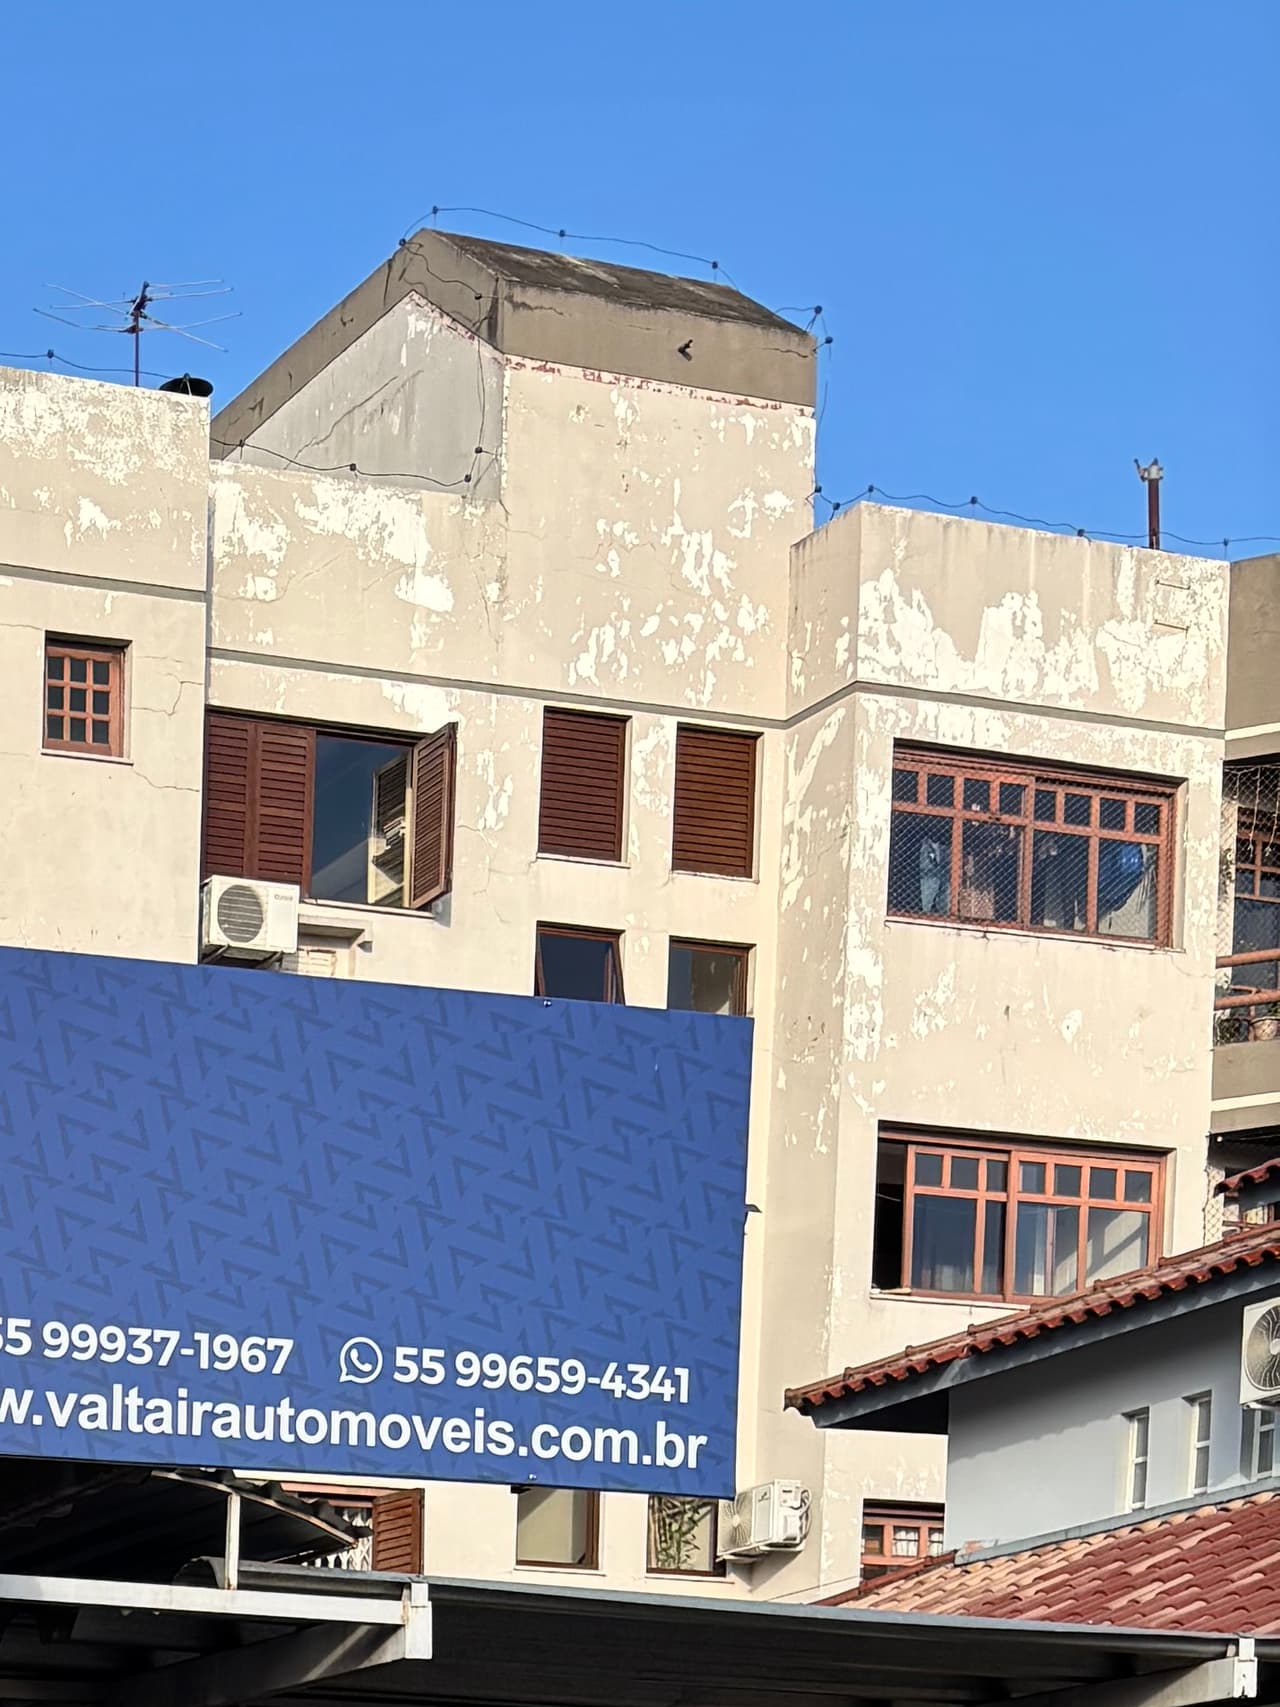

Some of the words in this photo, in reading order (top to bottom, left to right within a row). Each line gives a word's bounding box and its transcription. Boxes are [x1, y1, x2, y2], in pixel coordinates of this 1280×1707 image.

[42, 1321, 295, 1375] 99937-1967
[393, 1346, 446, 1386] 55
[455, 1350, 689, 1404] 99659-4341
